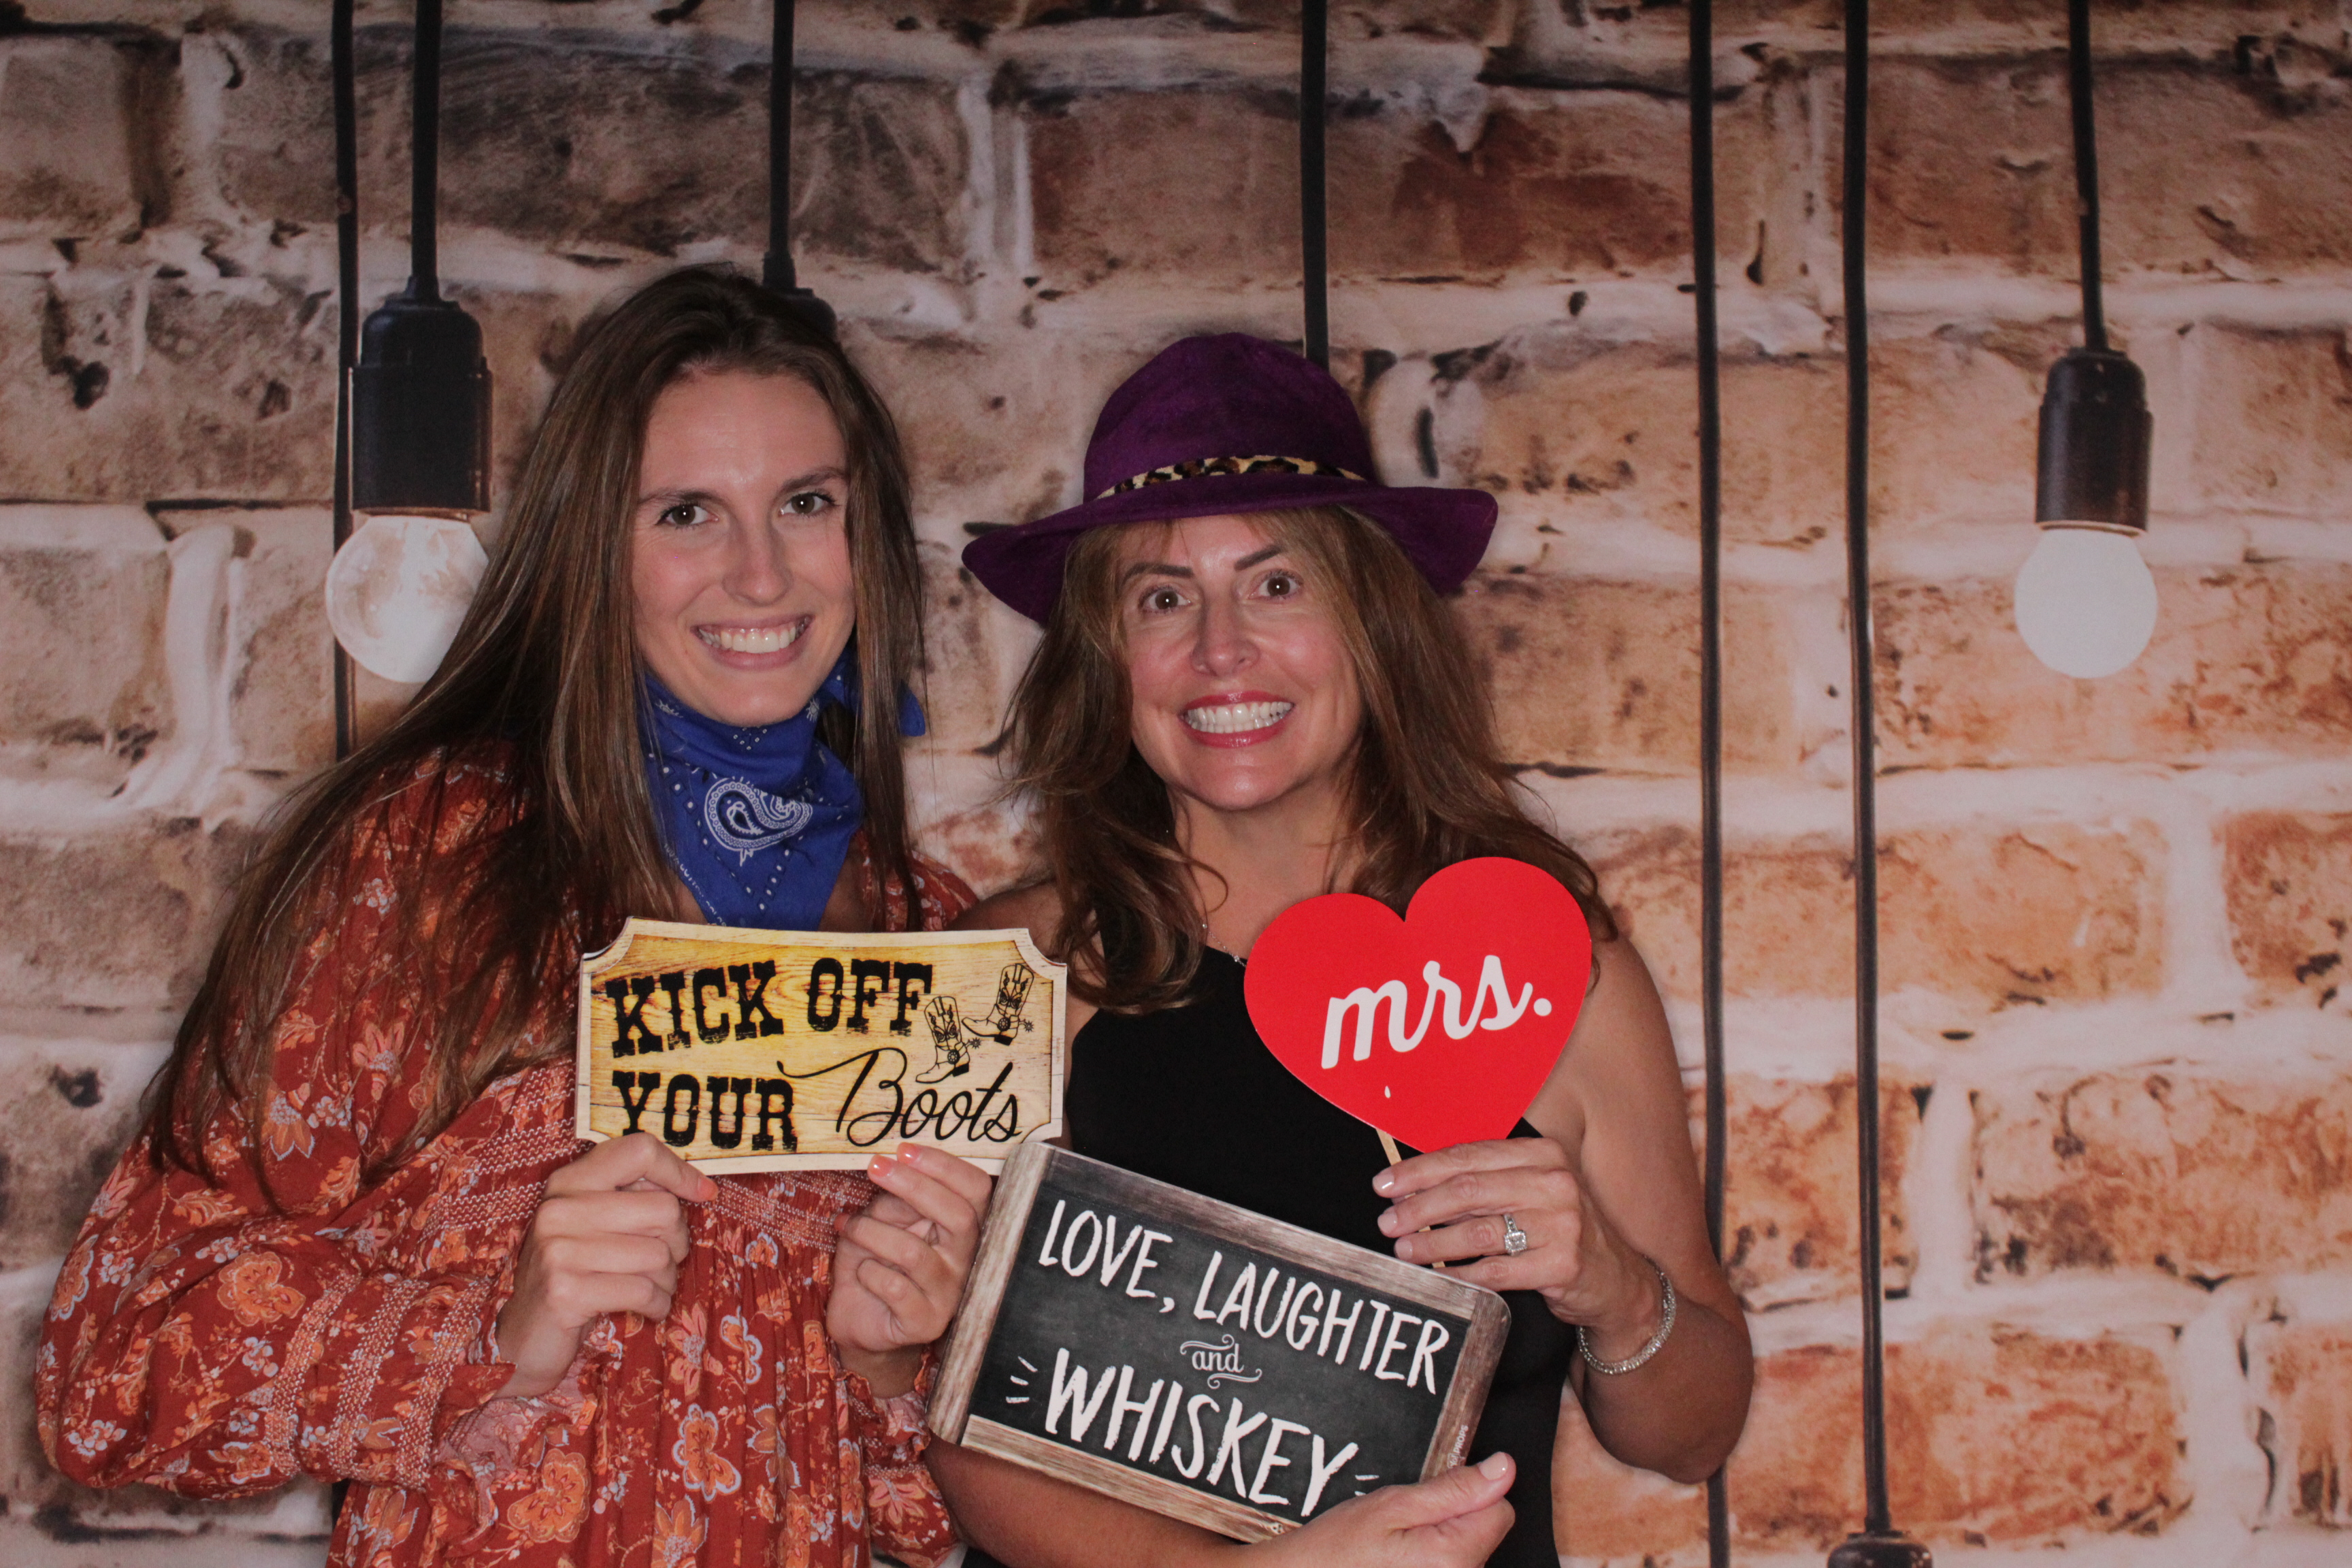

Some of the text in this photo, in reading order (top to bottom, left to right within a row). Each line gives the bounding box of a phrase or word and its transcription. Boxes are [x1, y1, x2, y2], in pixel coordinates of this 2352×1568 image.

[606, 957, 932, 1059] KICK OFF
[1321, 955, 1552, 1069] mrs.
[612, 1071, 798, 1151] YOUR
[777, 1047, 1021, 1147] Boots
[1038, 1200, 1450, 1395] LOVE, LAUGHTER
[1192, 1343, 1244, 1373] and
[1045, 1348, 1359, 1517] WHISKEY
[1453, 1425, 1469, 1453] PROPS
